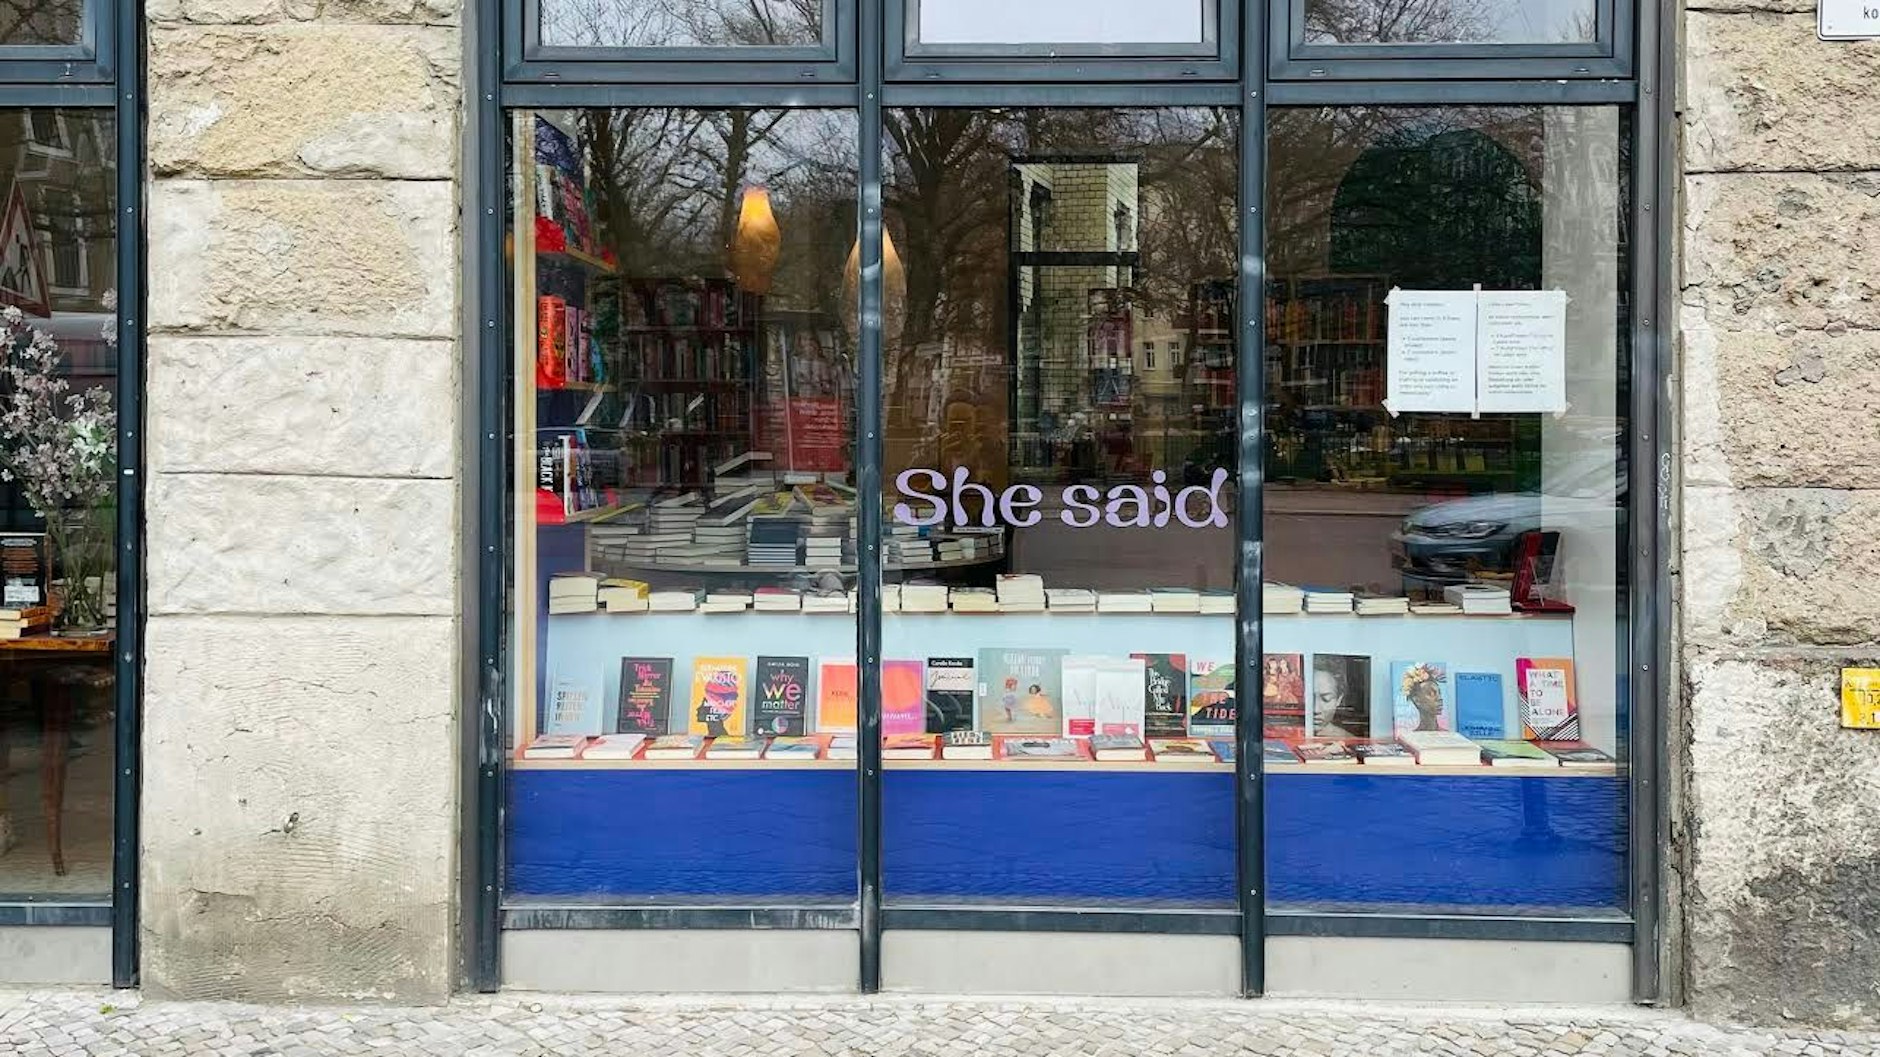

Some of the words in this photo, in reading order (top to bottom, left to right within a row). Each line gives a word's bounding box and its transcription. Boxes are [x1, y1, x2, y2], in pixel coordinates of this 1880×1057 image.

[540, 456, 554, 484] BLACK
[893, 465, 1043, 528] She
[1060, 466, 1229, 528] said
[1196, 661, 1215, 672] WE
[770, 669, 795, 684] why
[1528, 670, 1559, 679] WHAT
[1542, 680, 1564, 688] TIME
[1530, 689, 1543, 697] TO
[762, 699, 800, 710] matter
[1531, 699, 1541, 707] BE
[1531, 708, 1564, 716] ALONE
